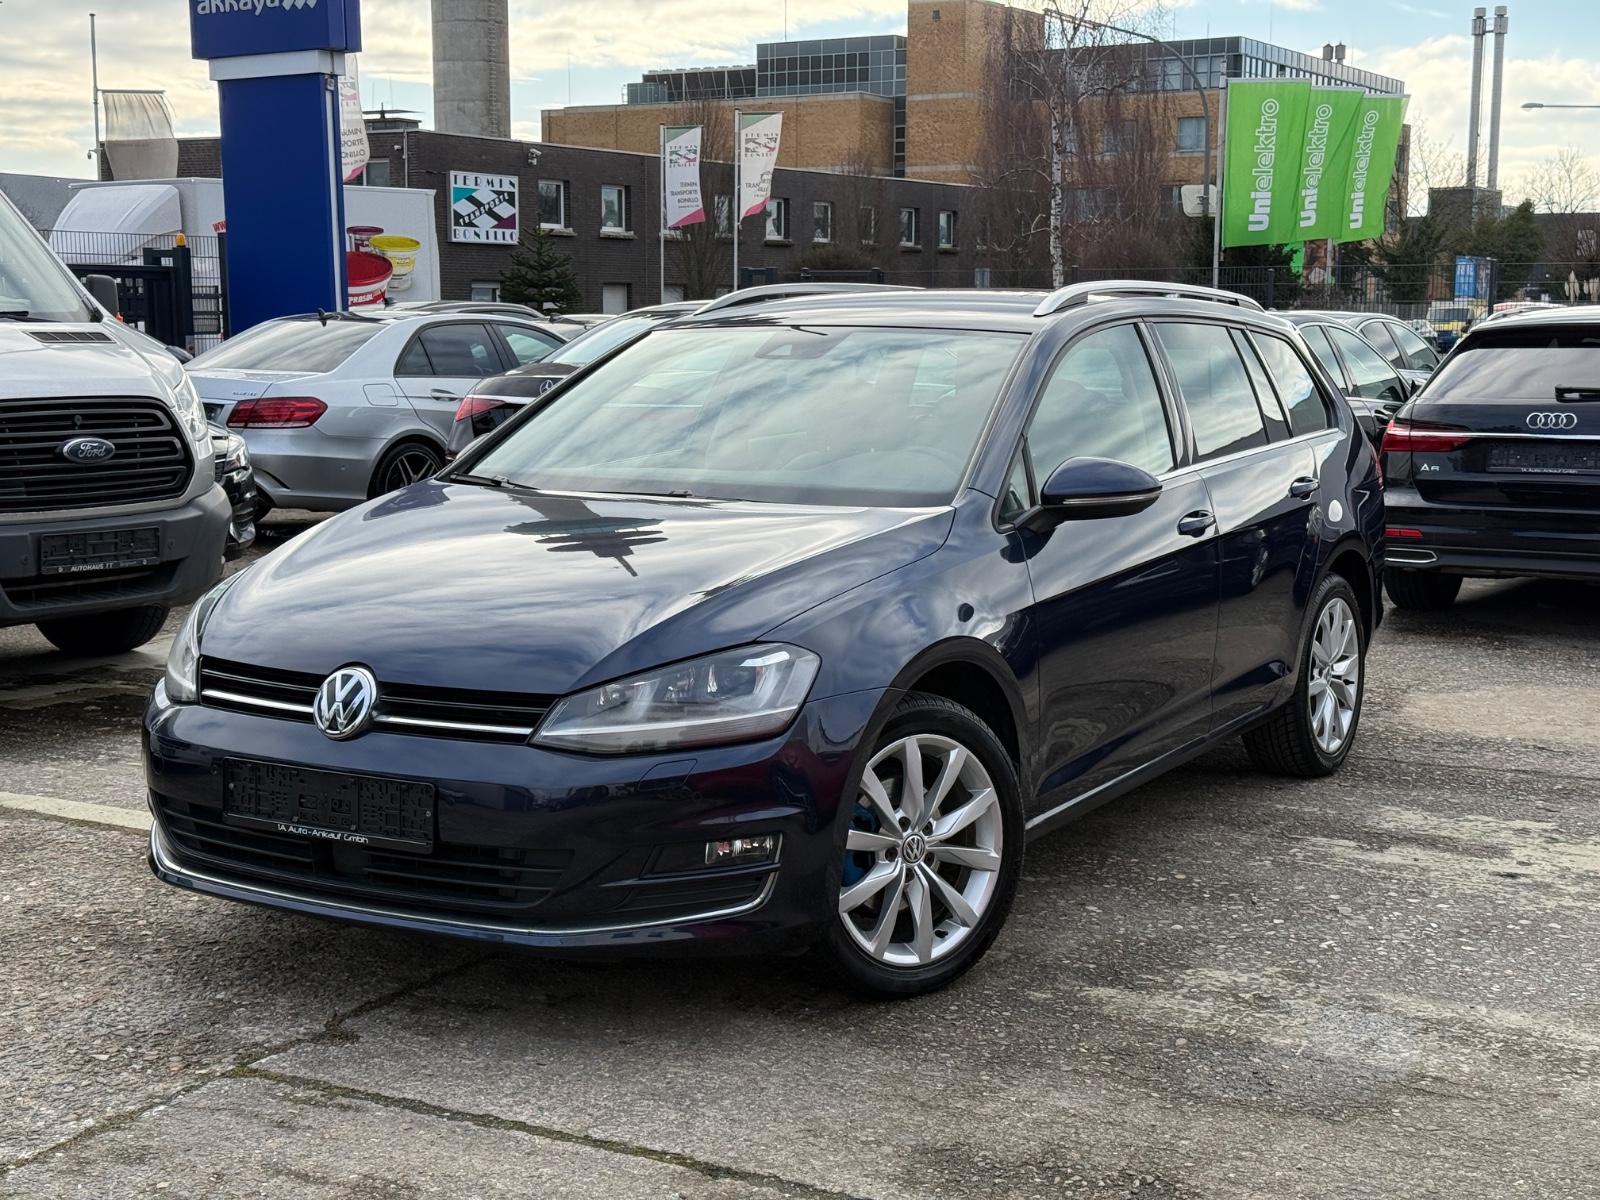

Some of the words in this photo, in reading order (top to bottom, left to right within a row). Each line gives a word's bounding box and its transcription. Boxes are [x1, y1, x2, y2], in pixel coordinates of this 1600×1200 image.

[1248, 98, 1279, 232] Unielektro
[453, 174, 516, 189] TERMIN
[459, 192, 509, 226] TRANSPORTE
[453, 228, 517, 241] BONILLO
[78, 442, 106, 458] Ford
[70, 563, 104, 572] AUTOHAUS
